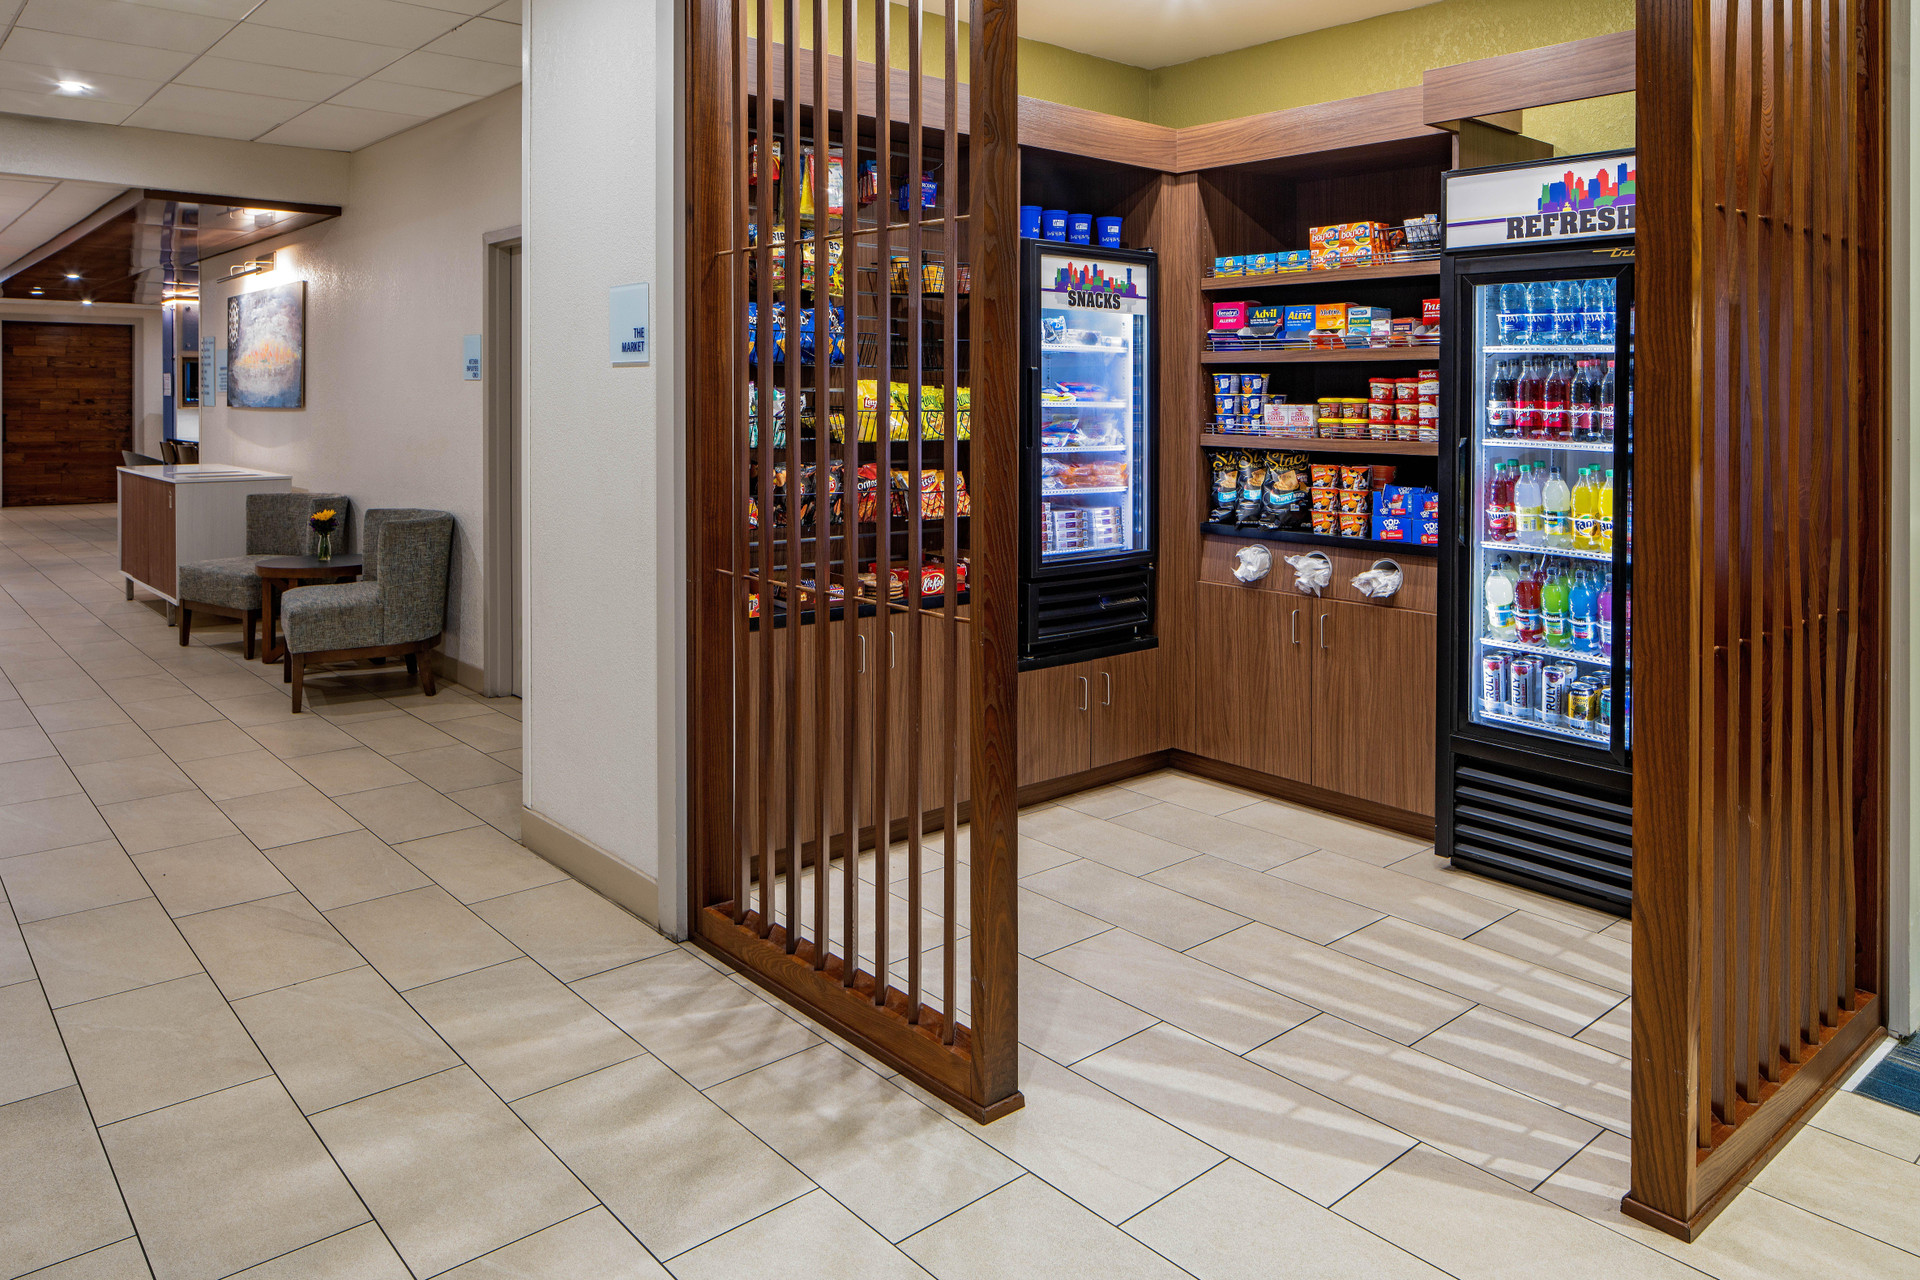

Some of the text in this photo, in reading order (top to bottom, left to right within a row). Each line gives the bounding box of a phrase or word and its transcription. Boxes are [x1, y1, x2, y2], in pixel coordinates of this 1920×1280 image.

[1067, 290, 1121, 310] SNACKS
[1252, 308, 1277, 319] Advil
[1287, 311, 1312, 321] ALEVE
[633, 327, 645, 339] THE
[621, 340, 645, 353] MARKET
[857, 479, 877, 491] oritos
[1485, 672, 1495, 700] RULY
[1512, 678, 1521, 707] RULY
[1545, 682, 1557, 713] RULY
